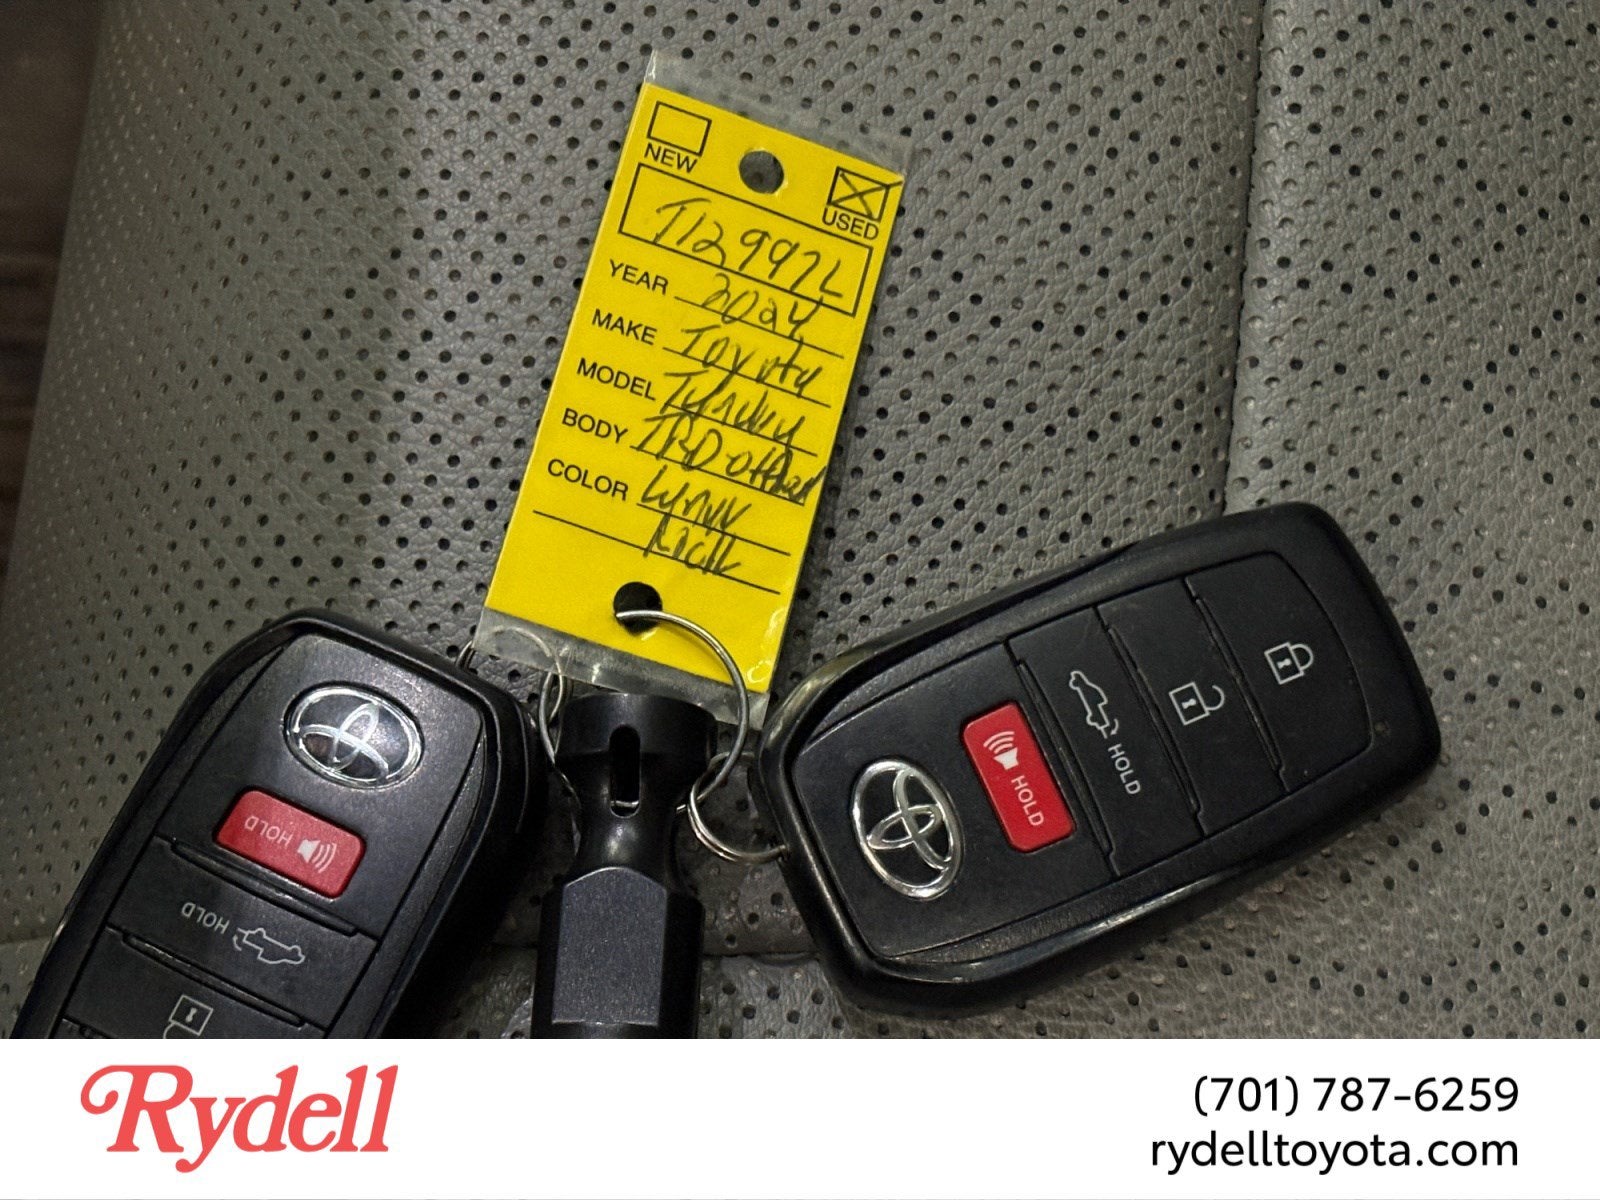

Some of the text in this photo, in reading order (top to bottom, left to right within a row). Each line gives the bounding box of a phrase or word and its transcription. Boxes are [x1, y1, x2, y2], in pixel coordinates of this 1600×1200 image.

[644, 144, 697, 173] NEW
[821, 206, 880, 242] USED
[608, 259, 669, 297] YEAR
[591, 308, 658, 345] MAKE
[577, 358, 656, 401] MODEL
[562, 408, 629, 444] BODY
[547, 458, 629, 502] COLOR
[1108, 744, 1141, 795] HOLD
[1011, 775, 1045, 827] HOLD
[244, 814, 292, 846] HOLD
[181, 902, 229, 934] HOLD
